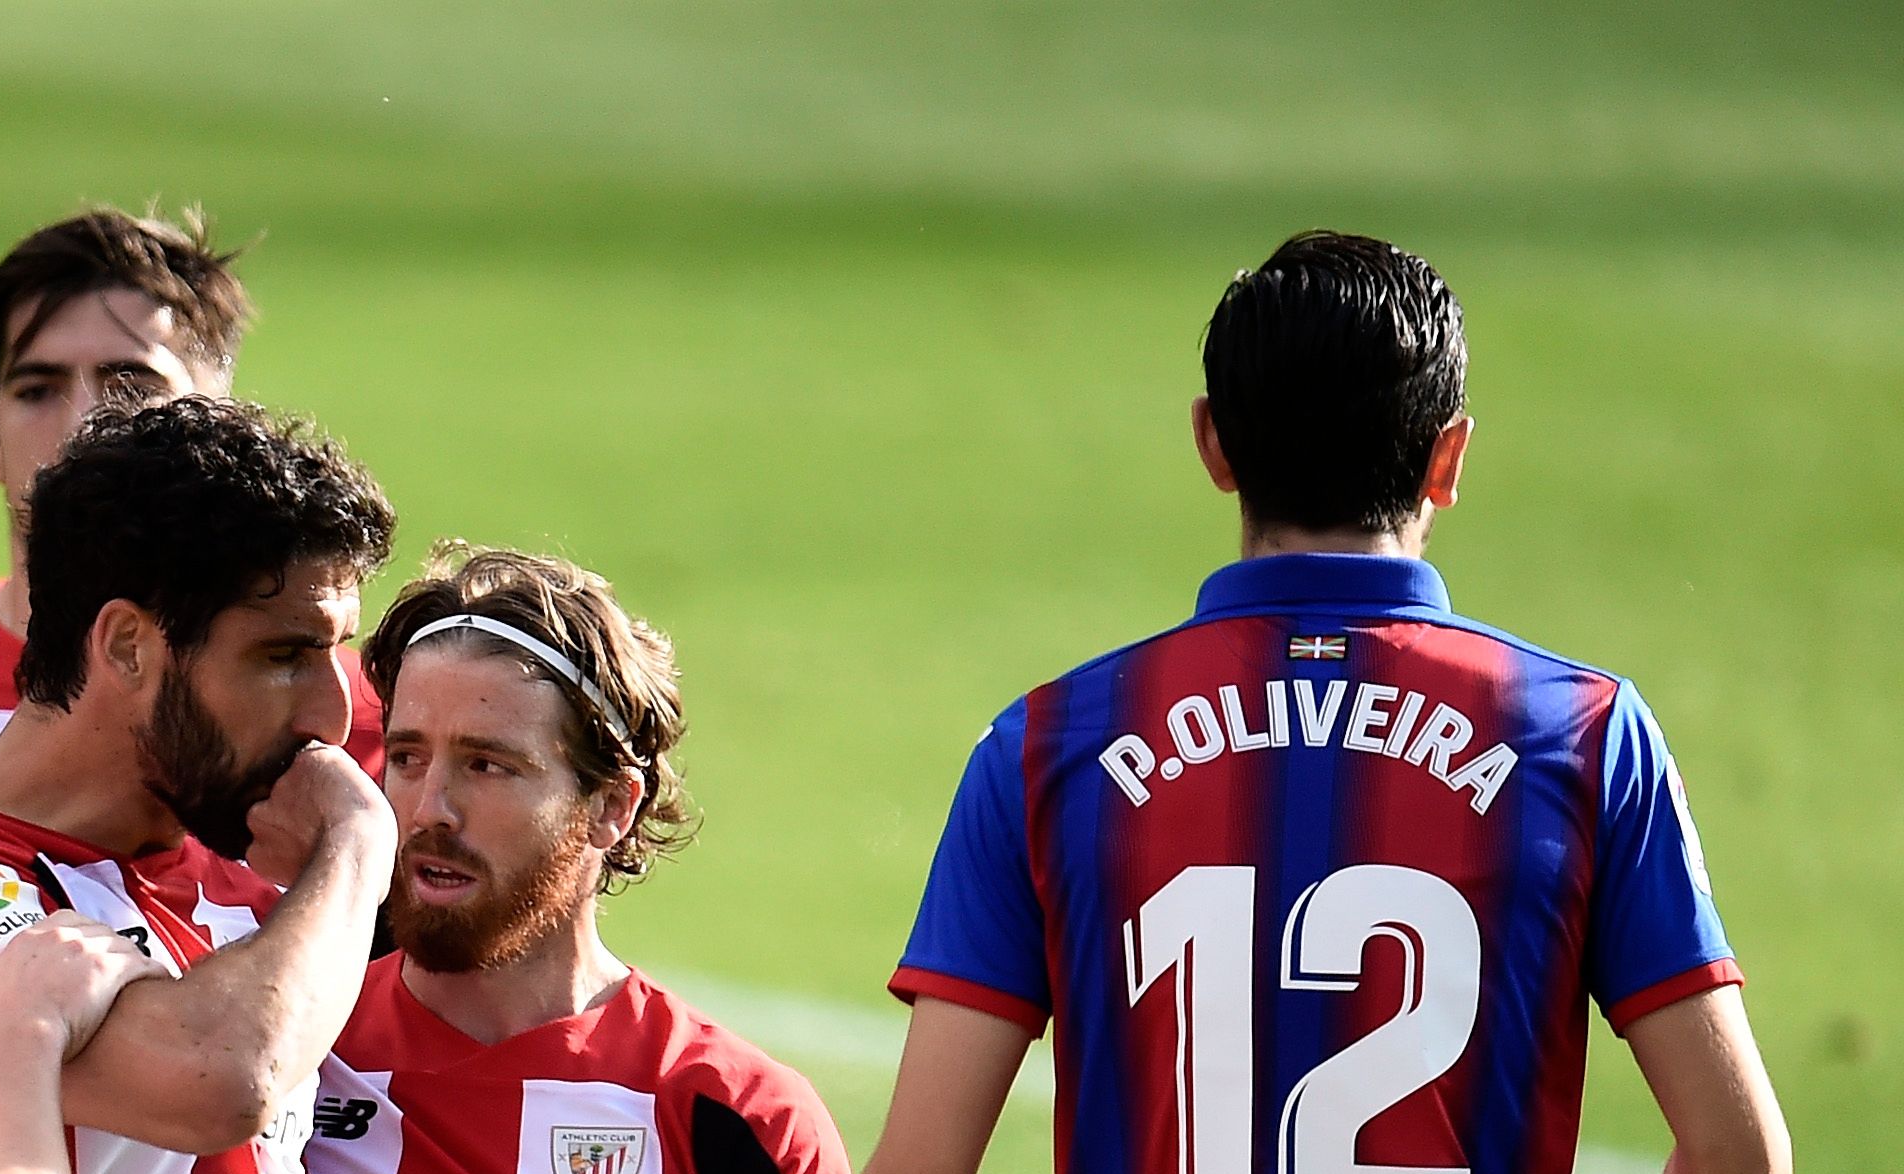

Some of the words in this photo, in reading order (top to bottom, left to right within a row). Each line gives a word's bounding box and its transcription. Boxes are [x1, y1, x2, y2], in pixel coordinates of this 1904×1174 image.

[1098, 679, 1519, 816] P.OLIVEIRA
[561, 1133, 608, 1142] ATHLETIC
[609, 1134, 637, 1142] CLUB
